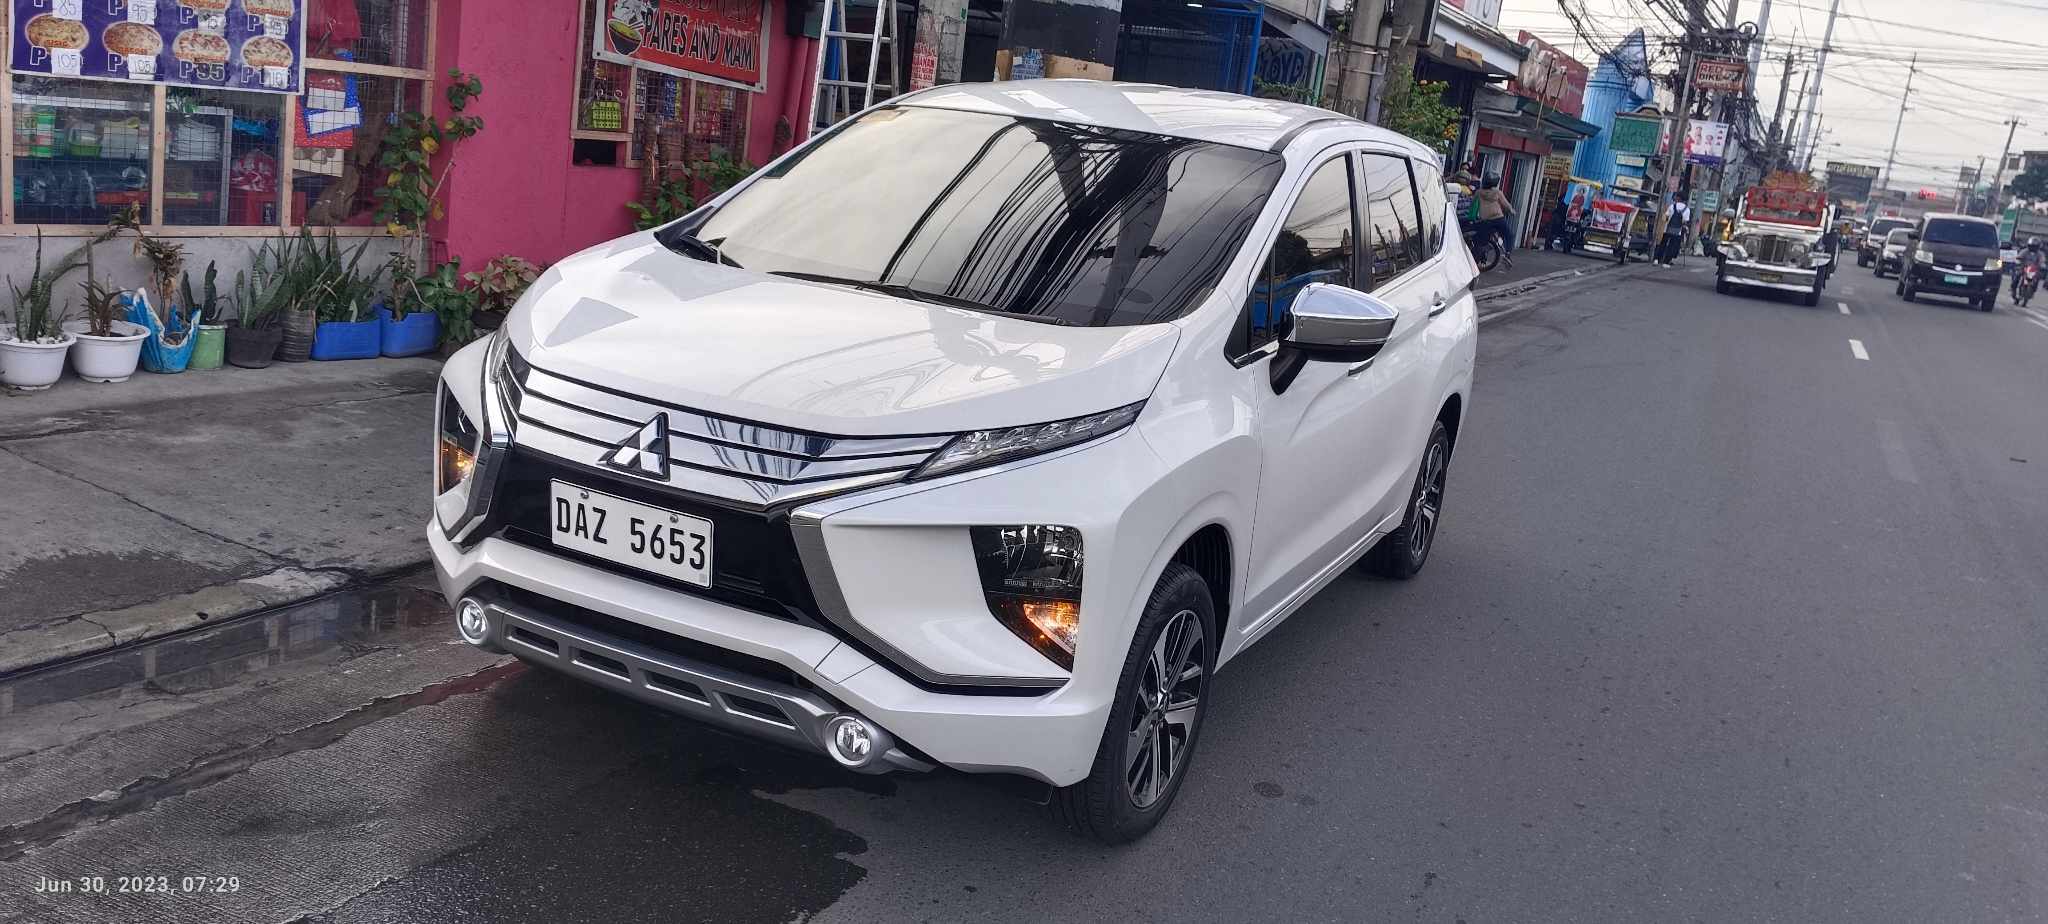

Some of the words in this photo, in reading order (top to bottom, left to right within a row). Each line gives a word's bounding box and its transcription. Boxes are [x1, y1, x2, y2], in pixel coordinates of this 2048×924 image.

[642, 8, 689, 57] PARES
[688, 20, 721, 64] AND
[721, 31, 758, 73] MAMI
[556, 497, 608, 545] DAZ
[630, 517, 706, 570] 5653
